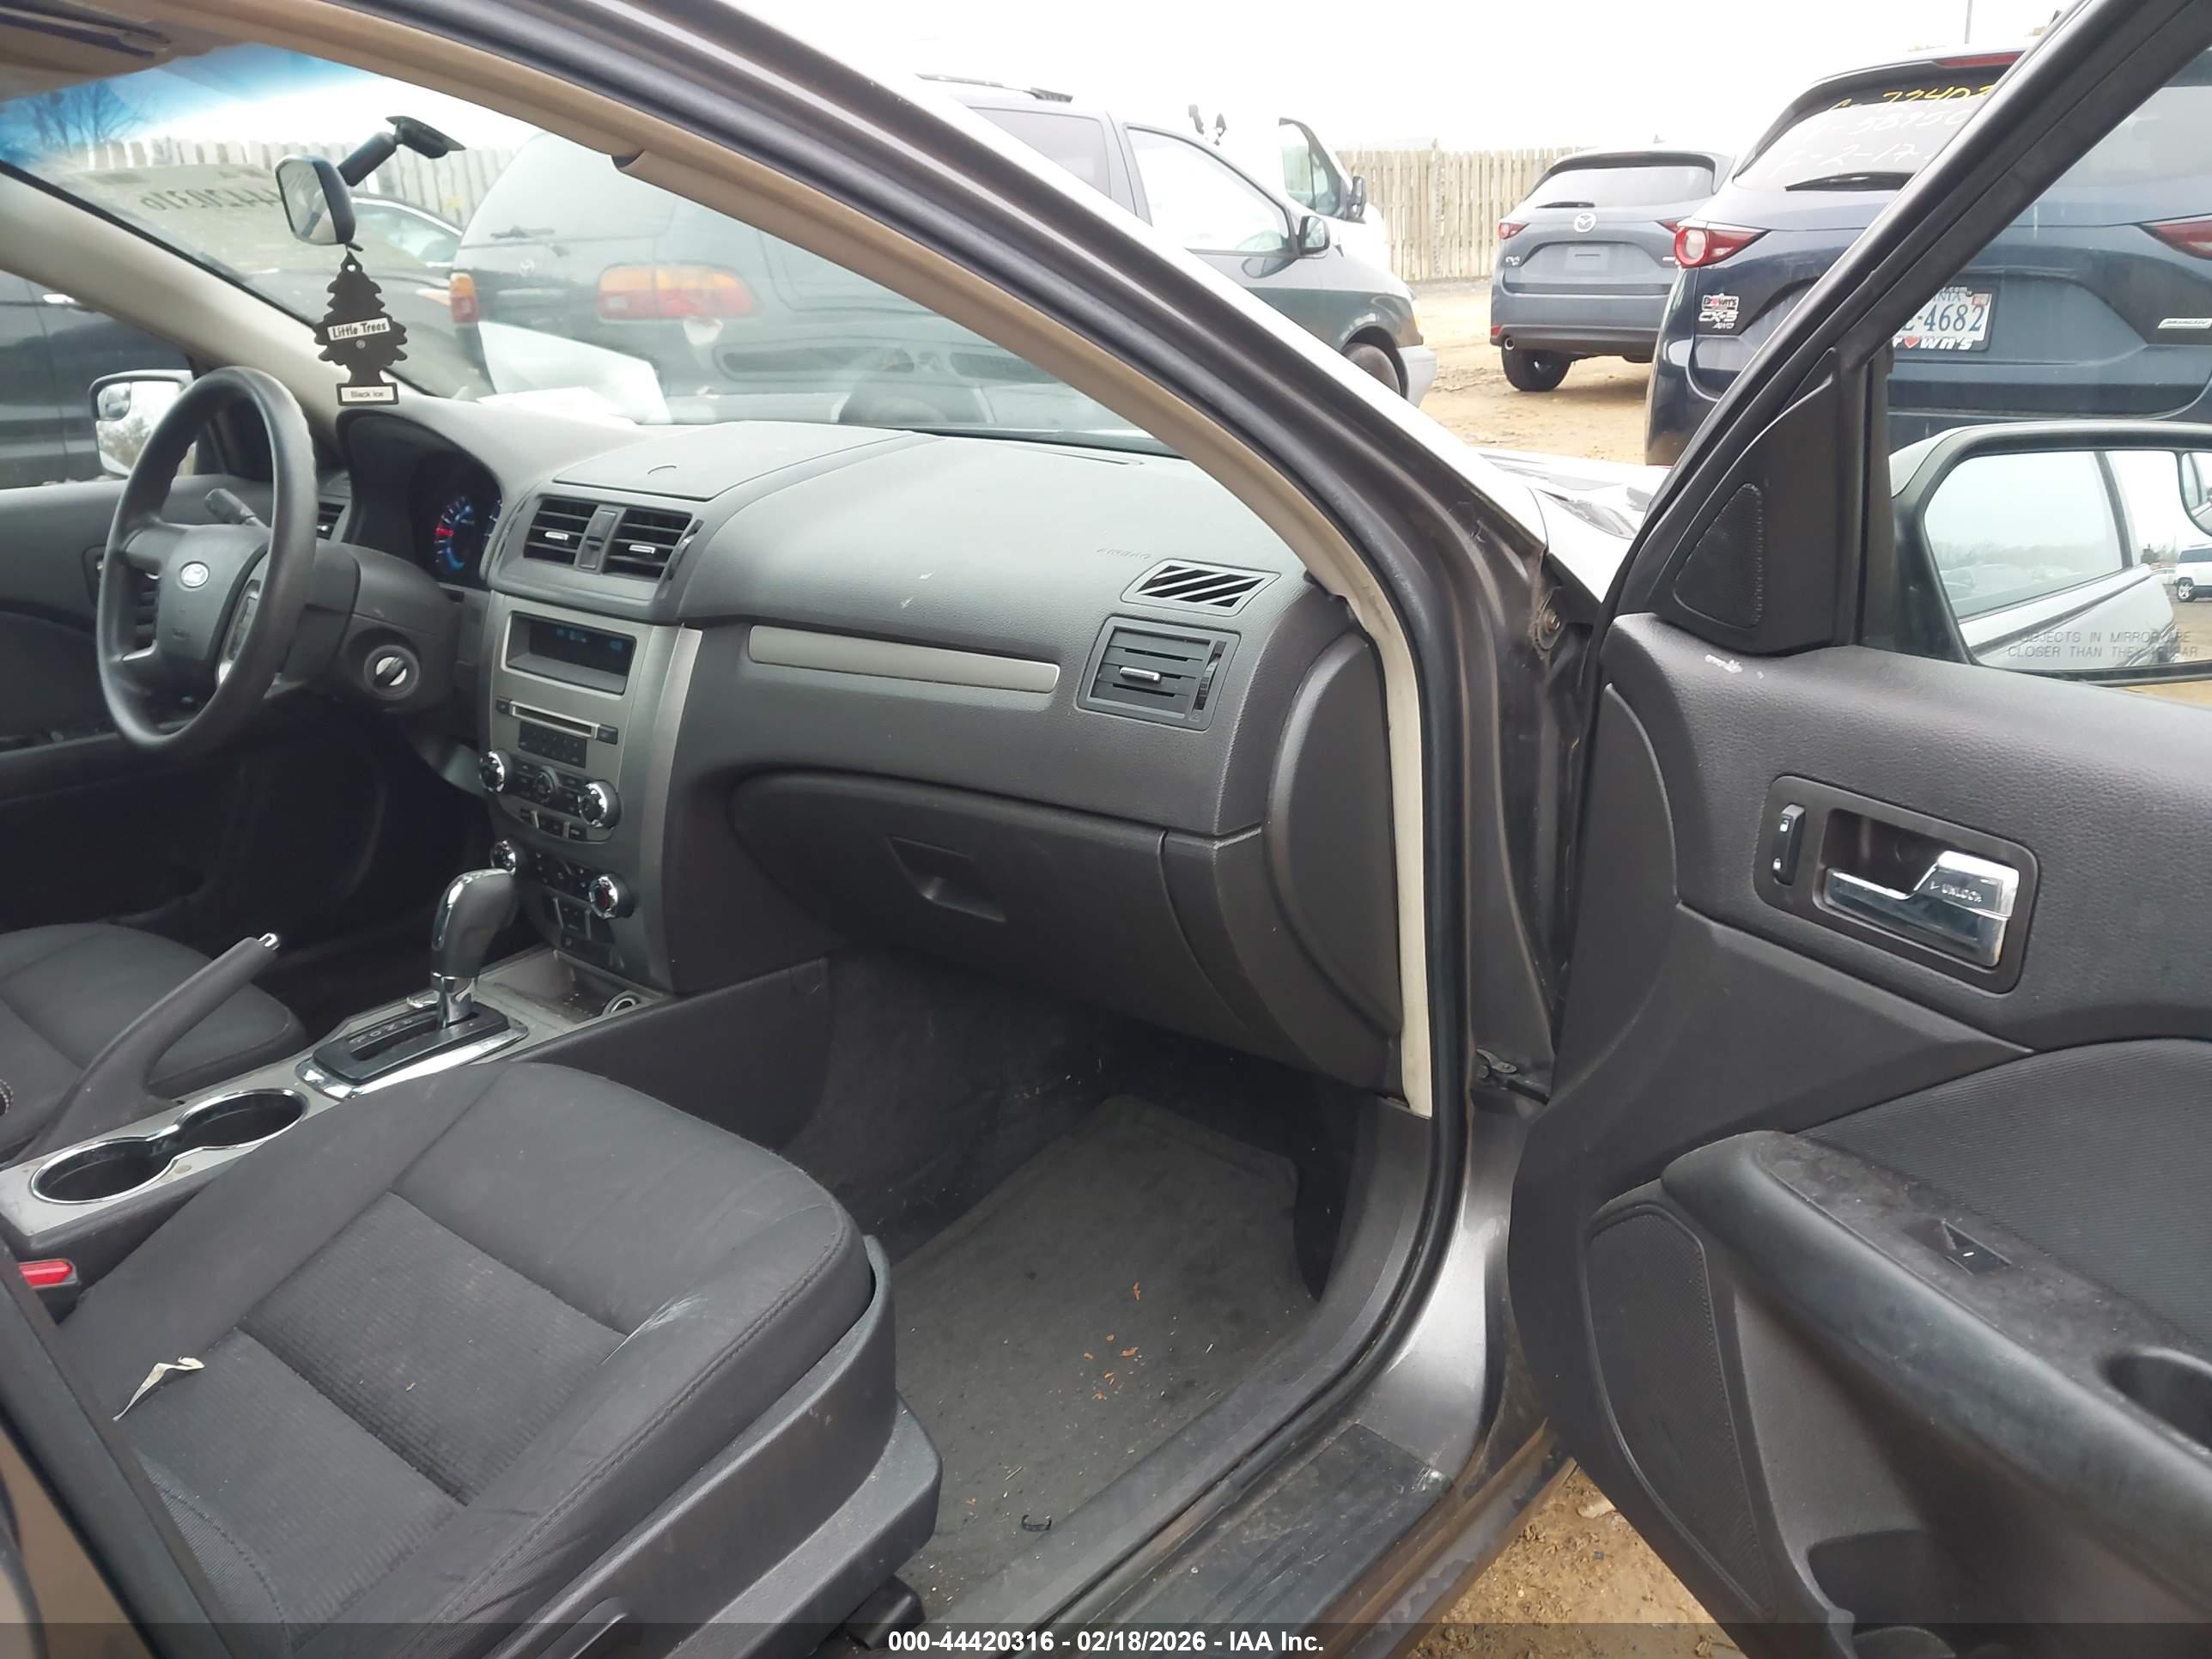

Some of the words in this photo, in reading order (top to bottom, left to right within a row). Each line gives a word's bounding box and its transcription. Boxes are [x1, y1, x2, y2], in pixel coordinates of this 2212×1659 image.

[332, 325, 358, 338] Little
[360, 323, 387, 334] Trees
[2089, 631, 2101, 643] IN
[2007, 646, 2061, 658] CLOSER
[2069, 646, 2103, 658] THAN
